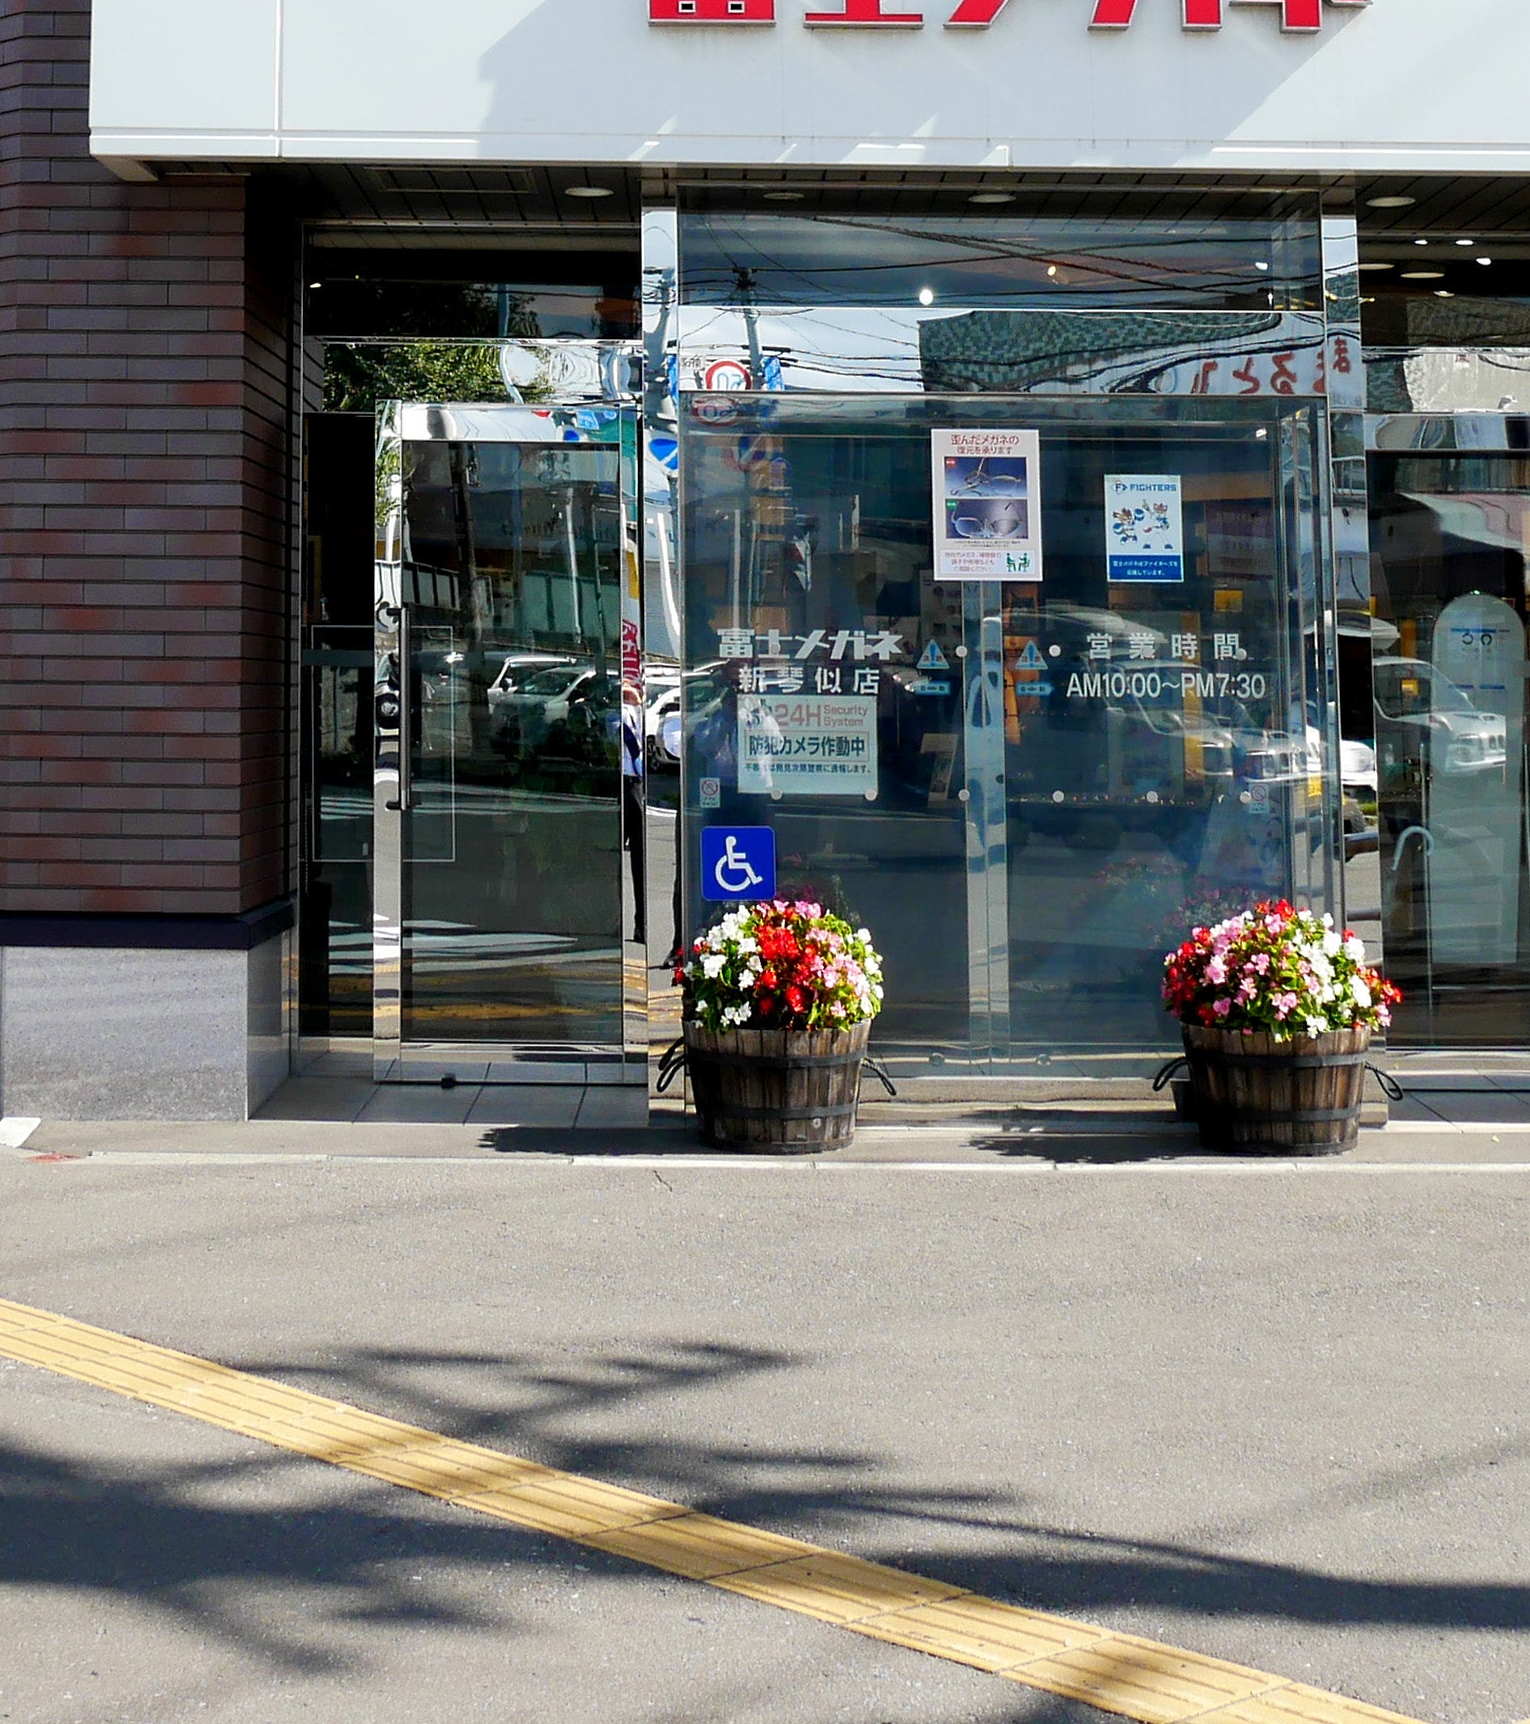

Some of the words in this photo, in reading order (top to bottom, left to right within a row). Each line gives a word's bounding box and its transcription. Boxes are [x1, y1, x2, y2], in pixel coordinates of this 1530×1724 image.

[951, 434, 1020, 446] 歪んだメガネの
[1129, 483, 1177, 492] FIGHTERS
[717, 629, 903, 660] 富士メガネ
[1086, 632, 1241, 660] 営業時間
[739, 666, 880, 693] 新琴似店
[774, 704, 822, 727] 24H
[824, 705, 868, 718] Security
[824, 717, 864, 728] System
[749, 735, 865, 756] 防犯カメラ作動中
